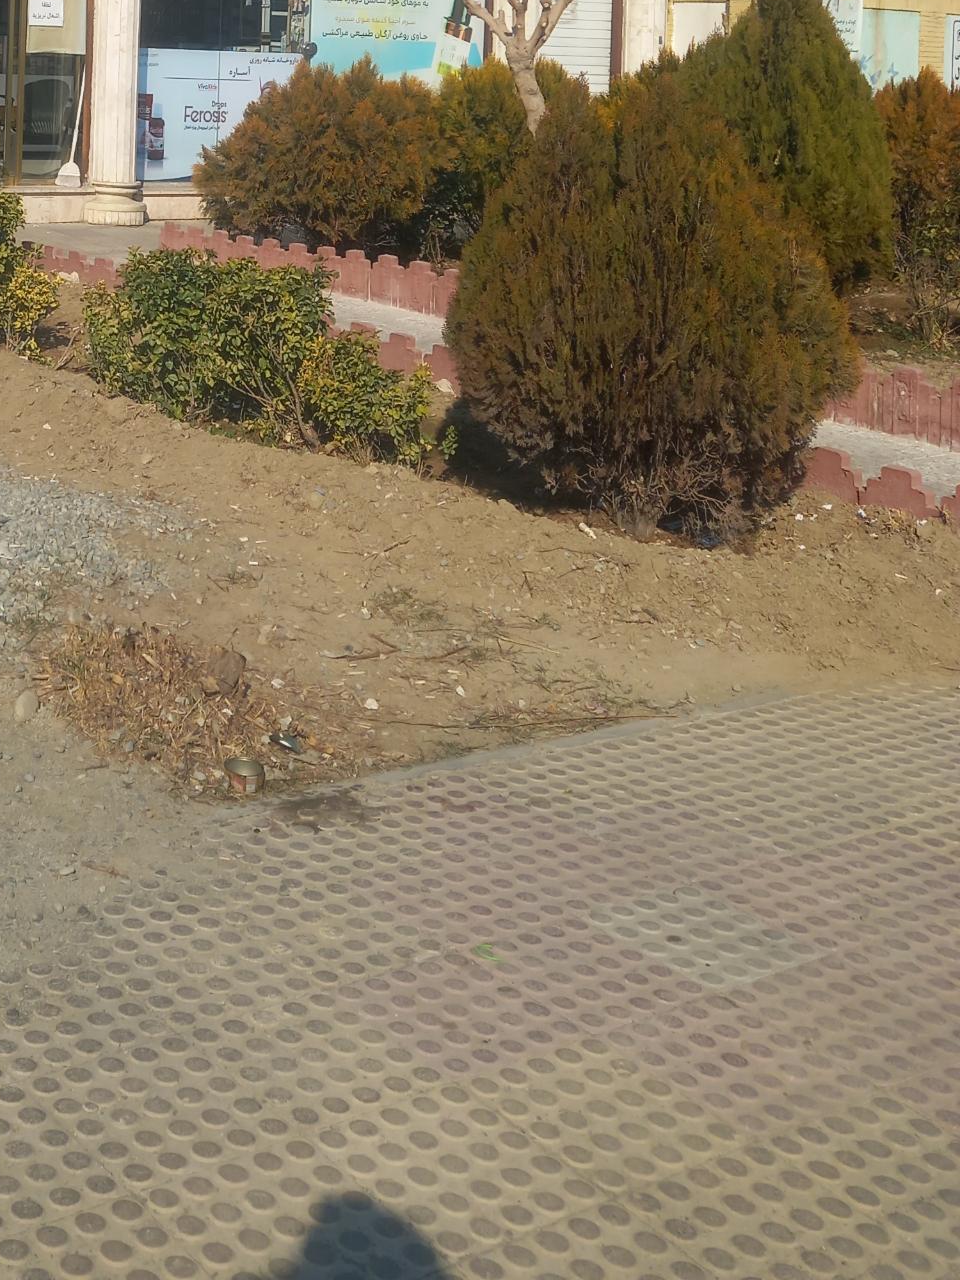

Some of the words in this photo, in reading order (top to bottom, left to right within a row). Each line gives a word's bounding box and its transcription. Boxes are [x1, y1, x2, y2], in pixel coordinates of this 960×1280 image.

[349, 30, 373, 39] طبیعی
[392, 31, 410, 41] روغن
[410, 32, 428, 41] حاوی
